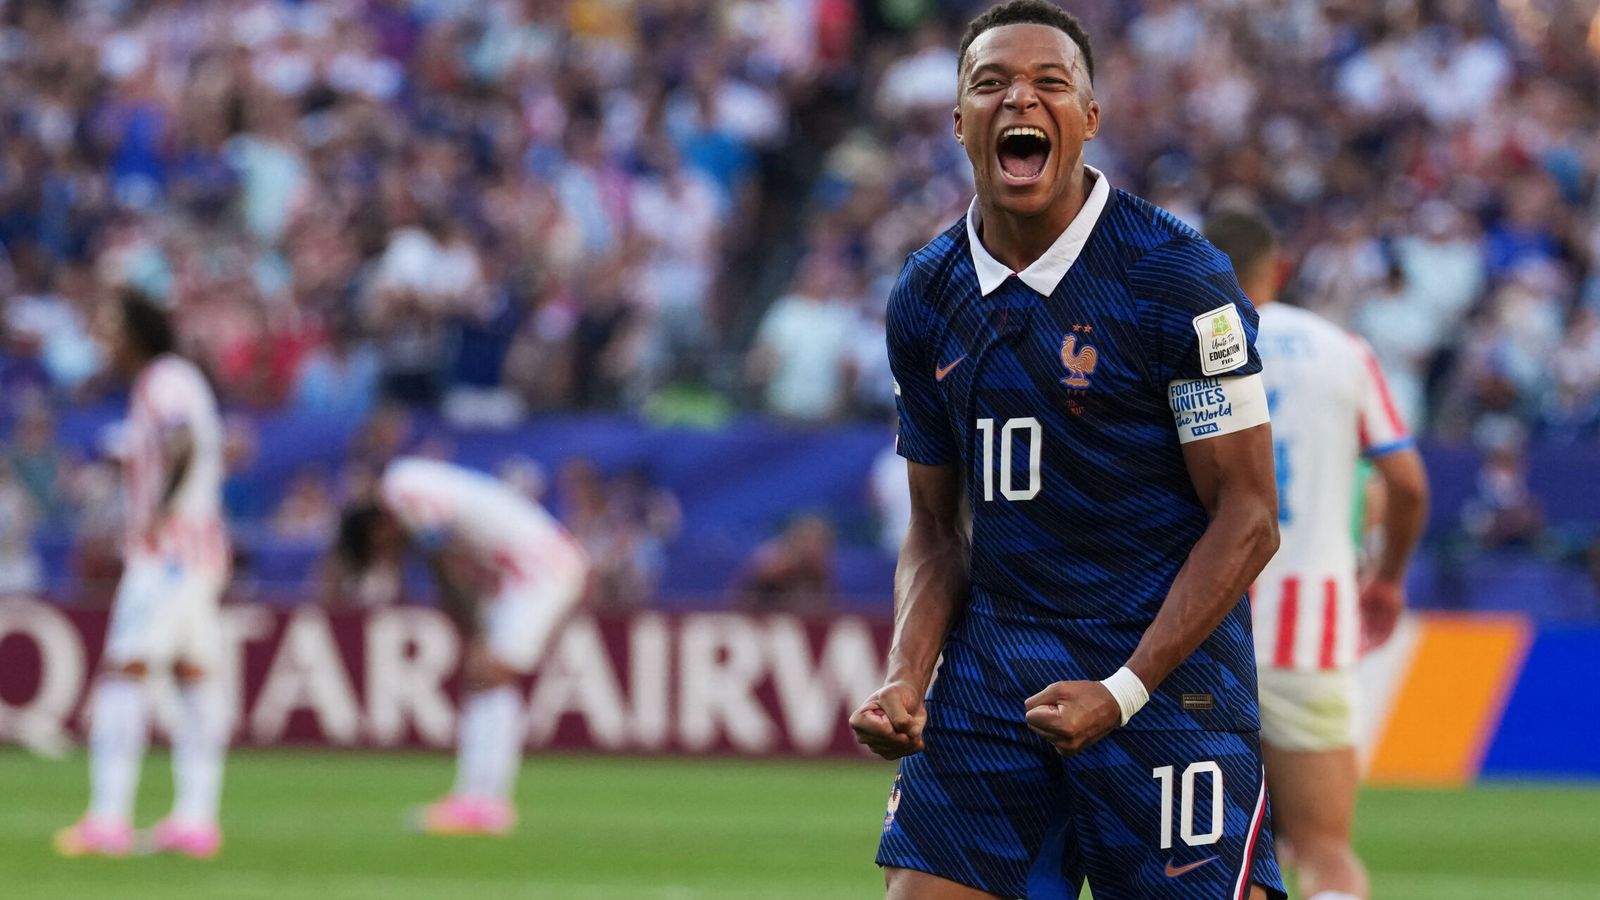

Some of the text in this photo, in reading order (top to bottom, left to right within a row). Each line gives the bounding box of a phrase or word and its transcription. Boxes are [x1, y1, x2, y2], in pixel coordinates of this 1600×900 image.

[1209, 344, 1240, 361] EDUCATION
[1171, 377, 1221, 397] FOOTBALL
[1172, 388, 1226, 413] UNITES
[1176, 403, 1232, 429] the World
[1194, 424, 1217, 436] FIFA
[976, 416, 1042, 502] 10
[0, 600, 461, 758] QTAR
[1152, 760, 1224, 850] 10
